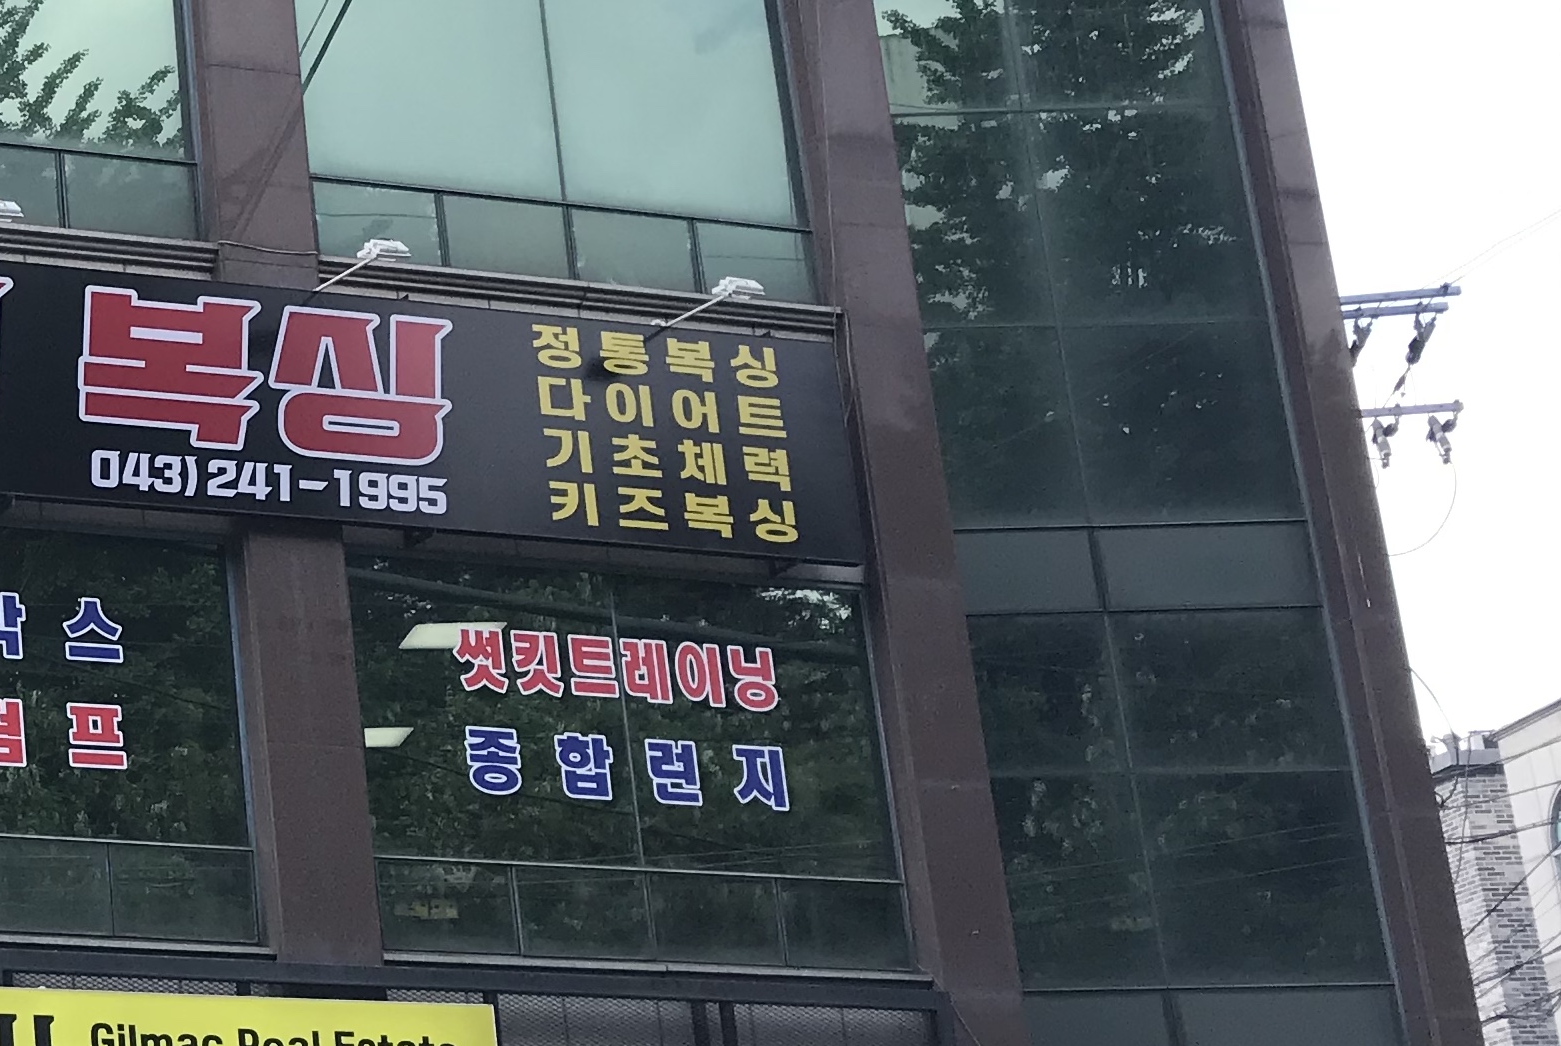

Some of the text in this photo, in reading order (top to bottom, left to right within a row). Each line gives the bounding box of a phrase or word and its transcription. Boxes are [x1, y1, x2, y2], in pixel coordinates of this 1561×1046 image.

[77, 285, 453, 465] 복싱
[532, 324, 778, 388] 정통복싱
[538, 376, 787, 437] 다이어트
[543, 428, 791, 491] 기초체력
[549, 481, 798, 543] 키즈복싱
